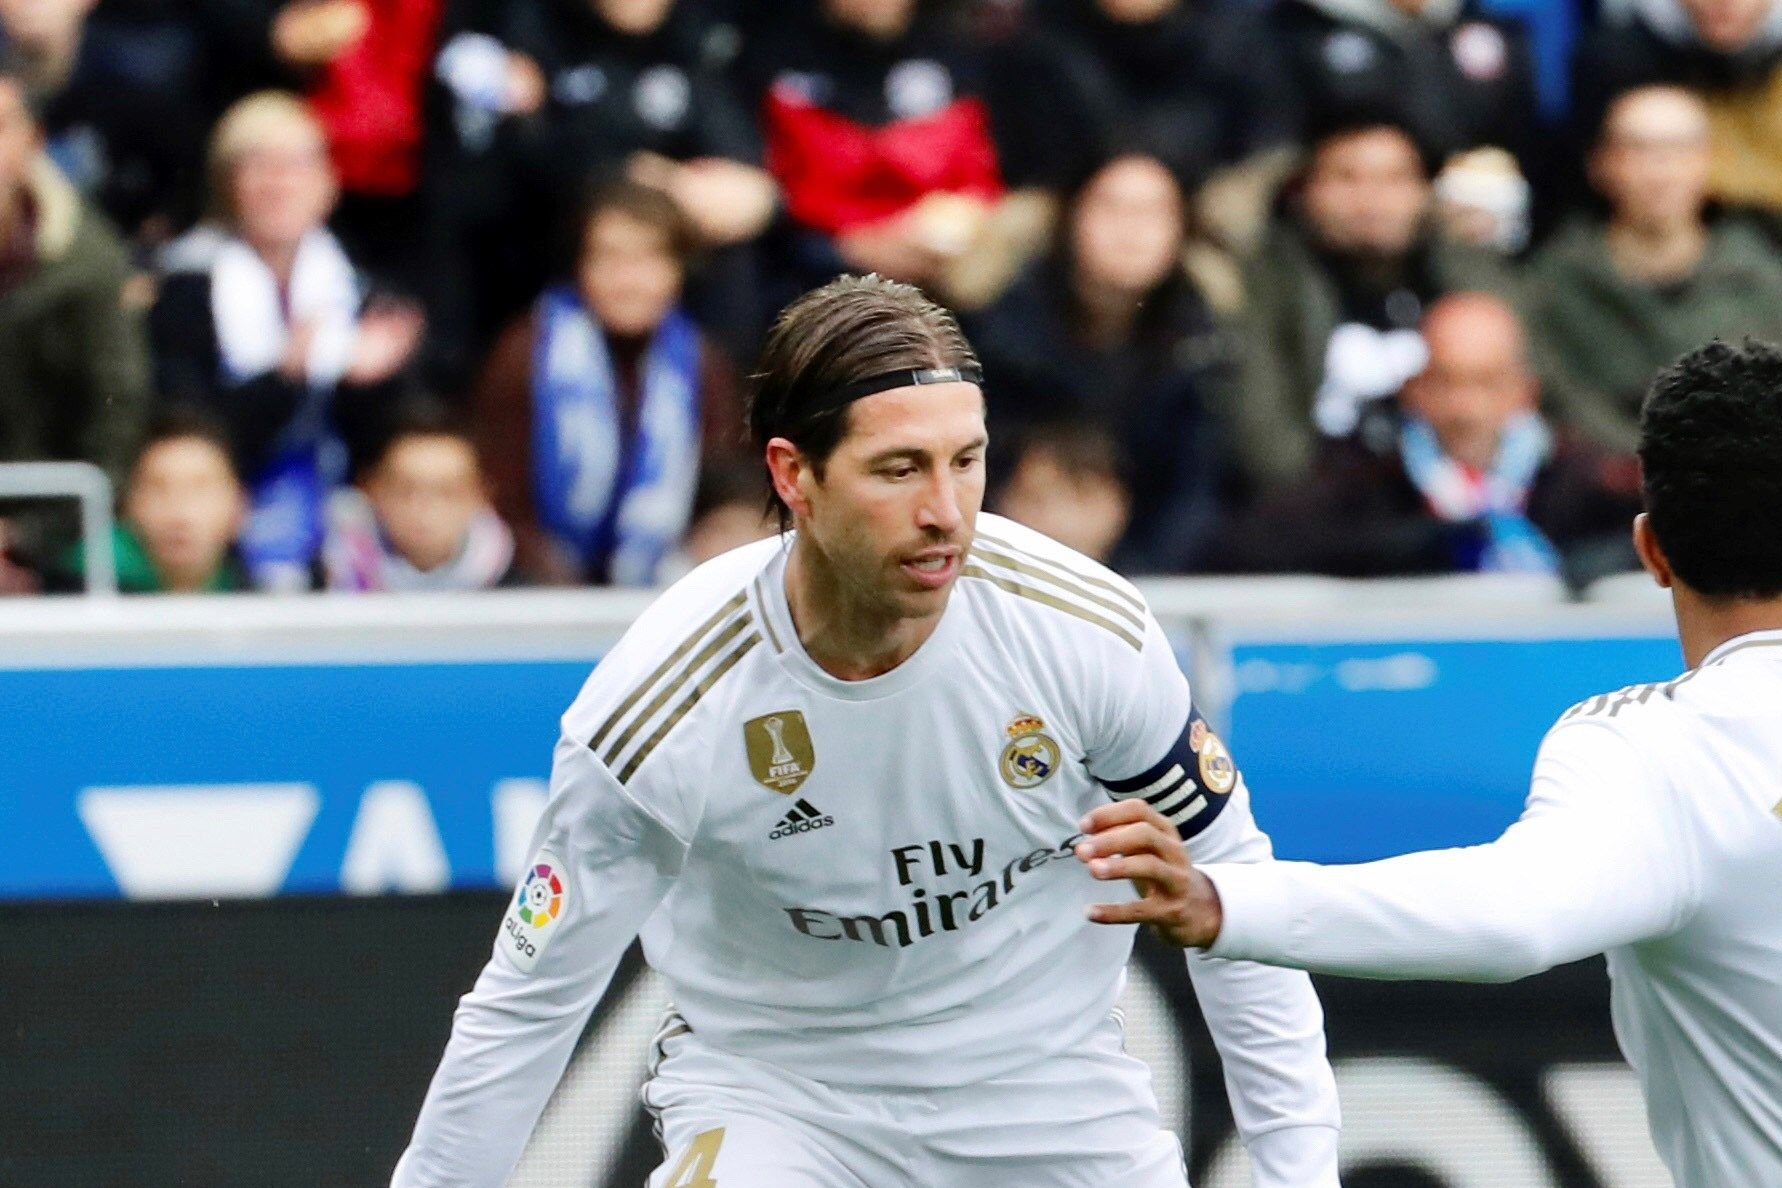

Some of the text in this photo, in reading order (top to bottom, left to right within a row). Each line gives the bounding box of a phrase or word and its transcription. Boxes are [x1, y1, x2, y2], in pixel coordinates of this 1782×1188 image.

[768, 762, 801, 778] FIFA
[769, 815, 836, 841] adidas
[891, 838, 985, 886] Fly
